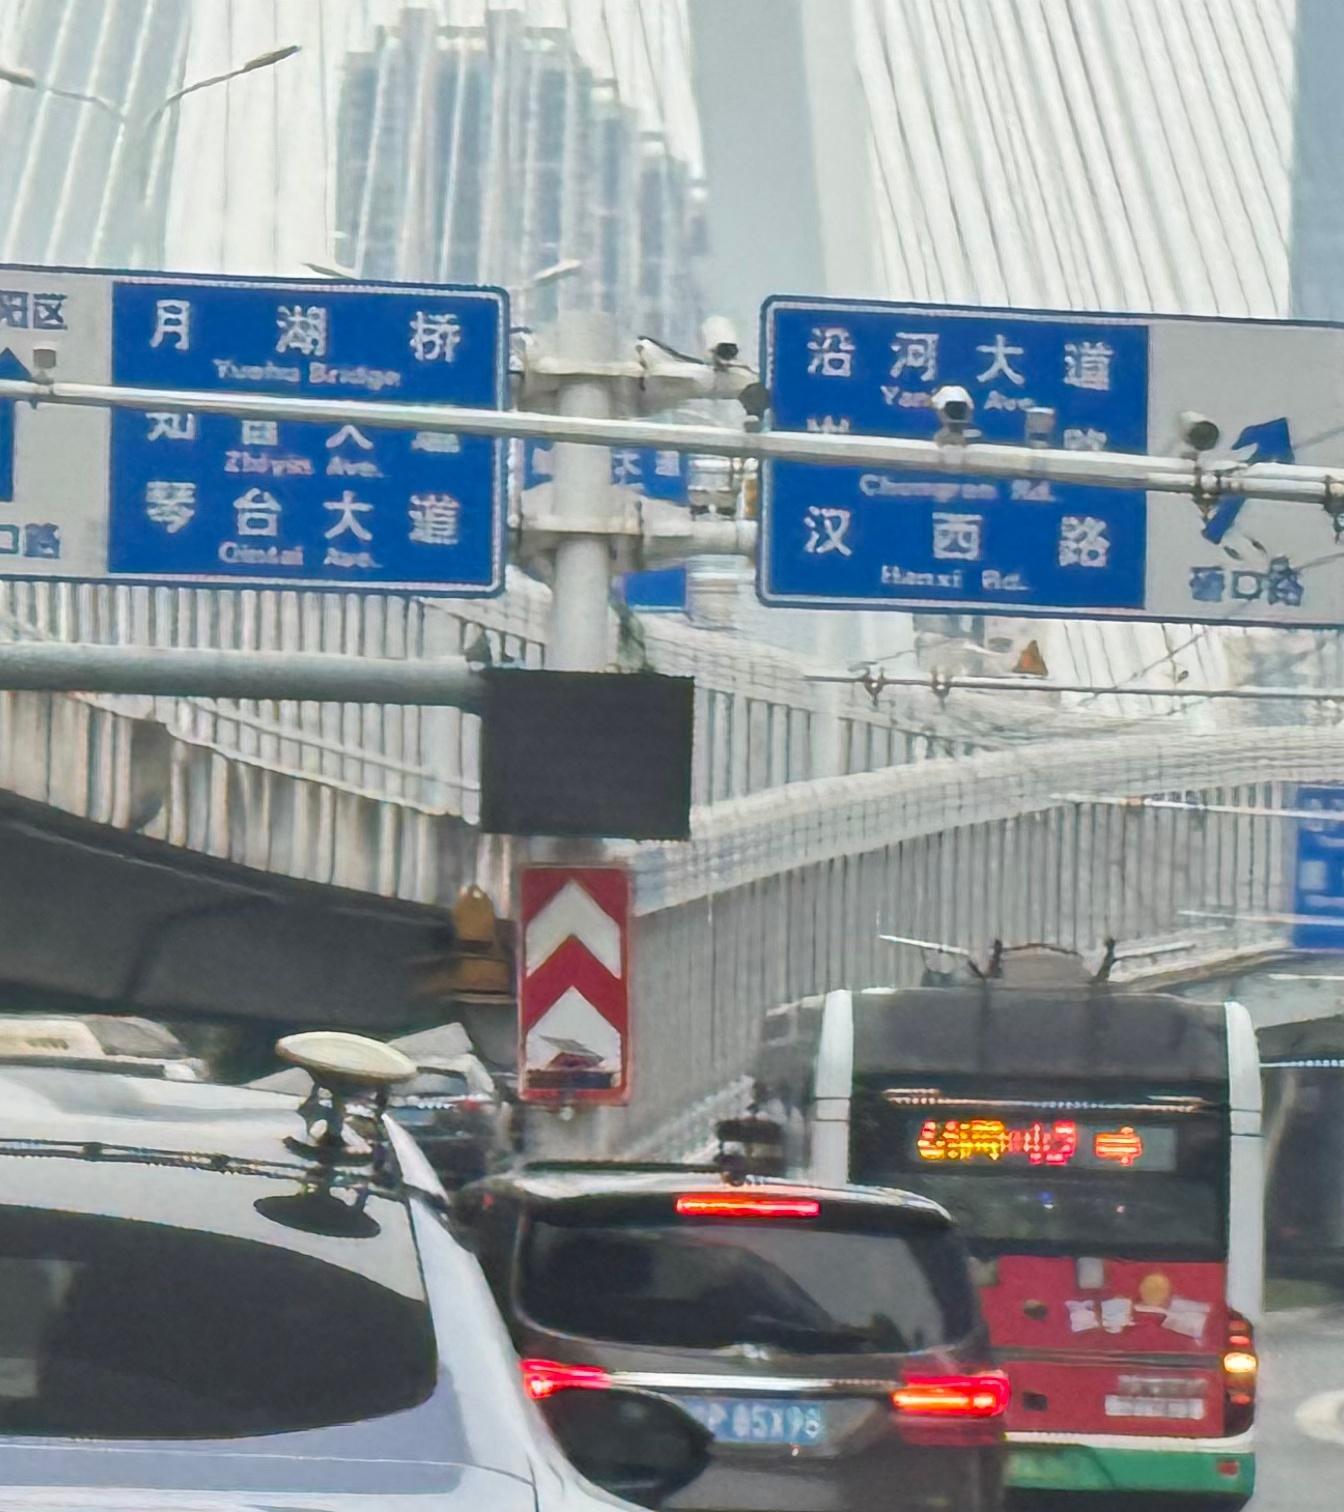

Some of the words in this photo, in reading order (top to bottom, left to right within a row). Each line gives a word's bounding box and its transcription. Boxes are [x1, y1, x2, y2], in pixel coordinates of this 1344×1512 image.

[149, 299, 460, 363] 月湖桥
[807, 327, 1114, 391] 沿河大道
[146, 480, 459, 544] 琴台大道
[804, 505, 1110, 567] 汉西路
